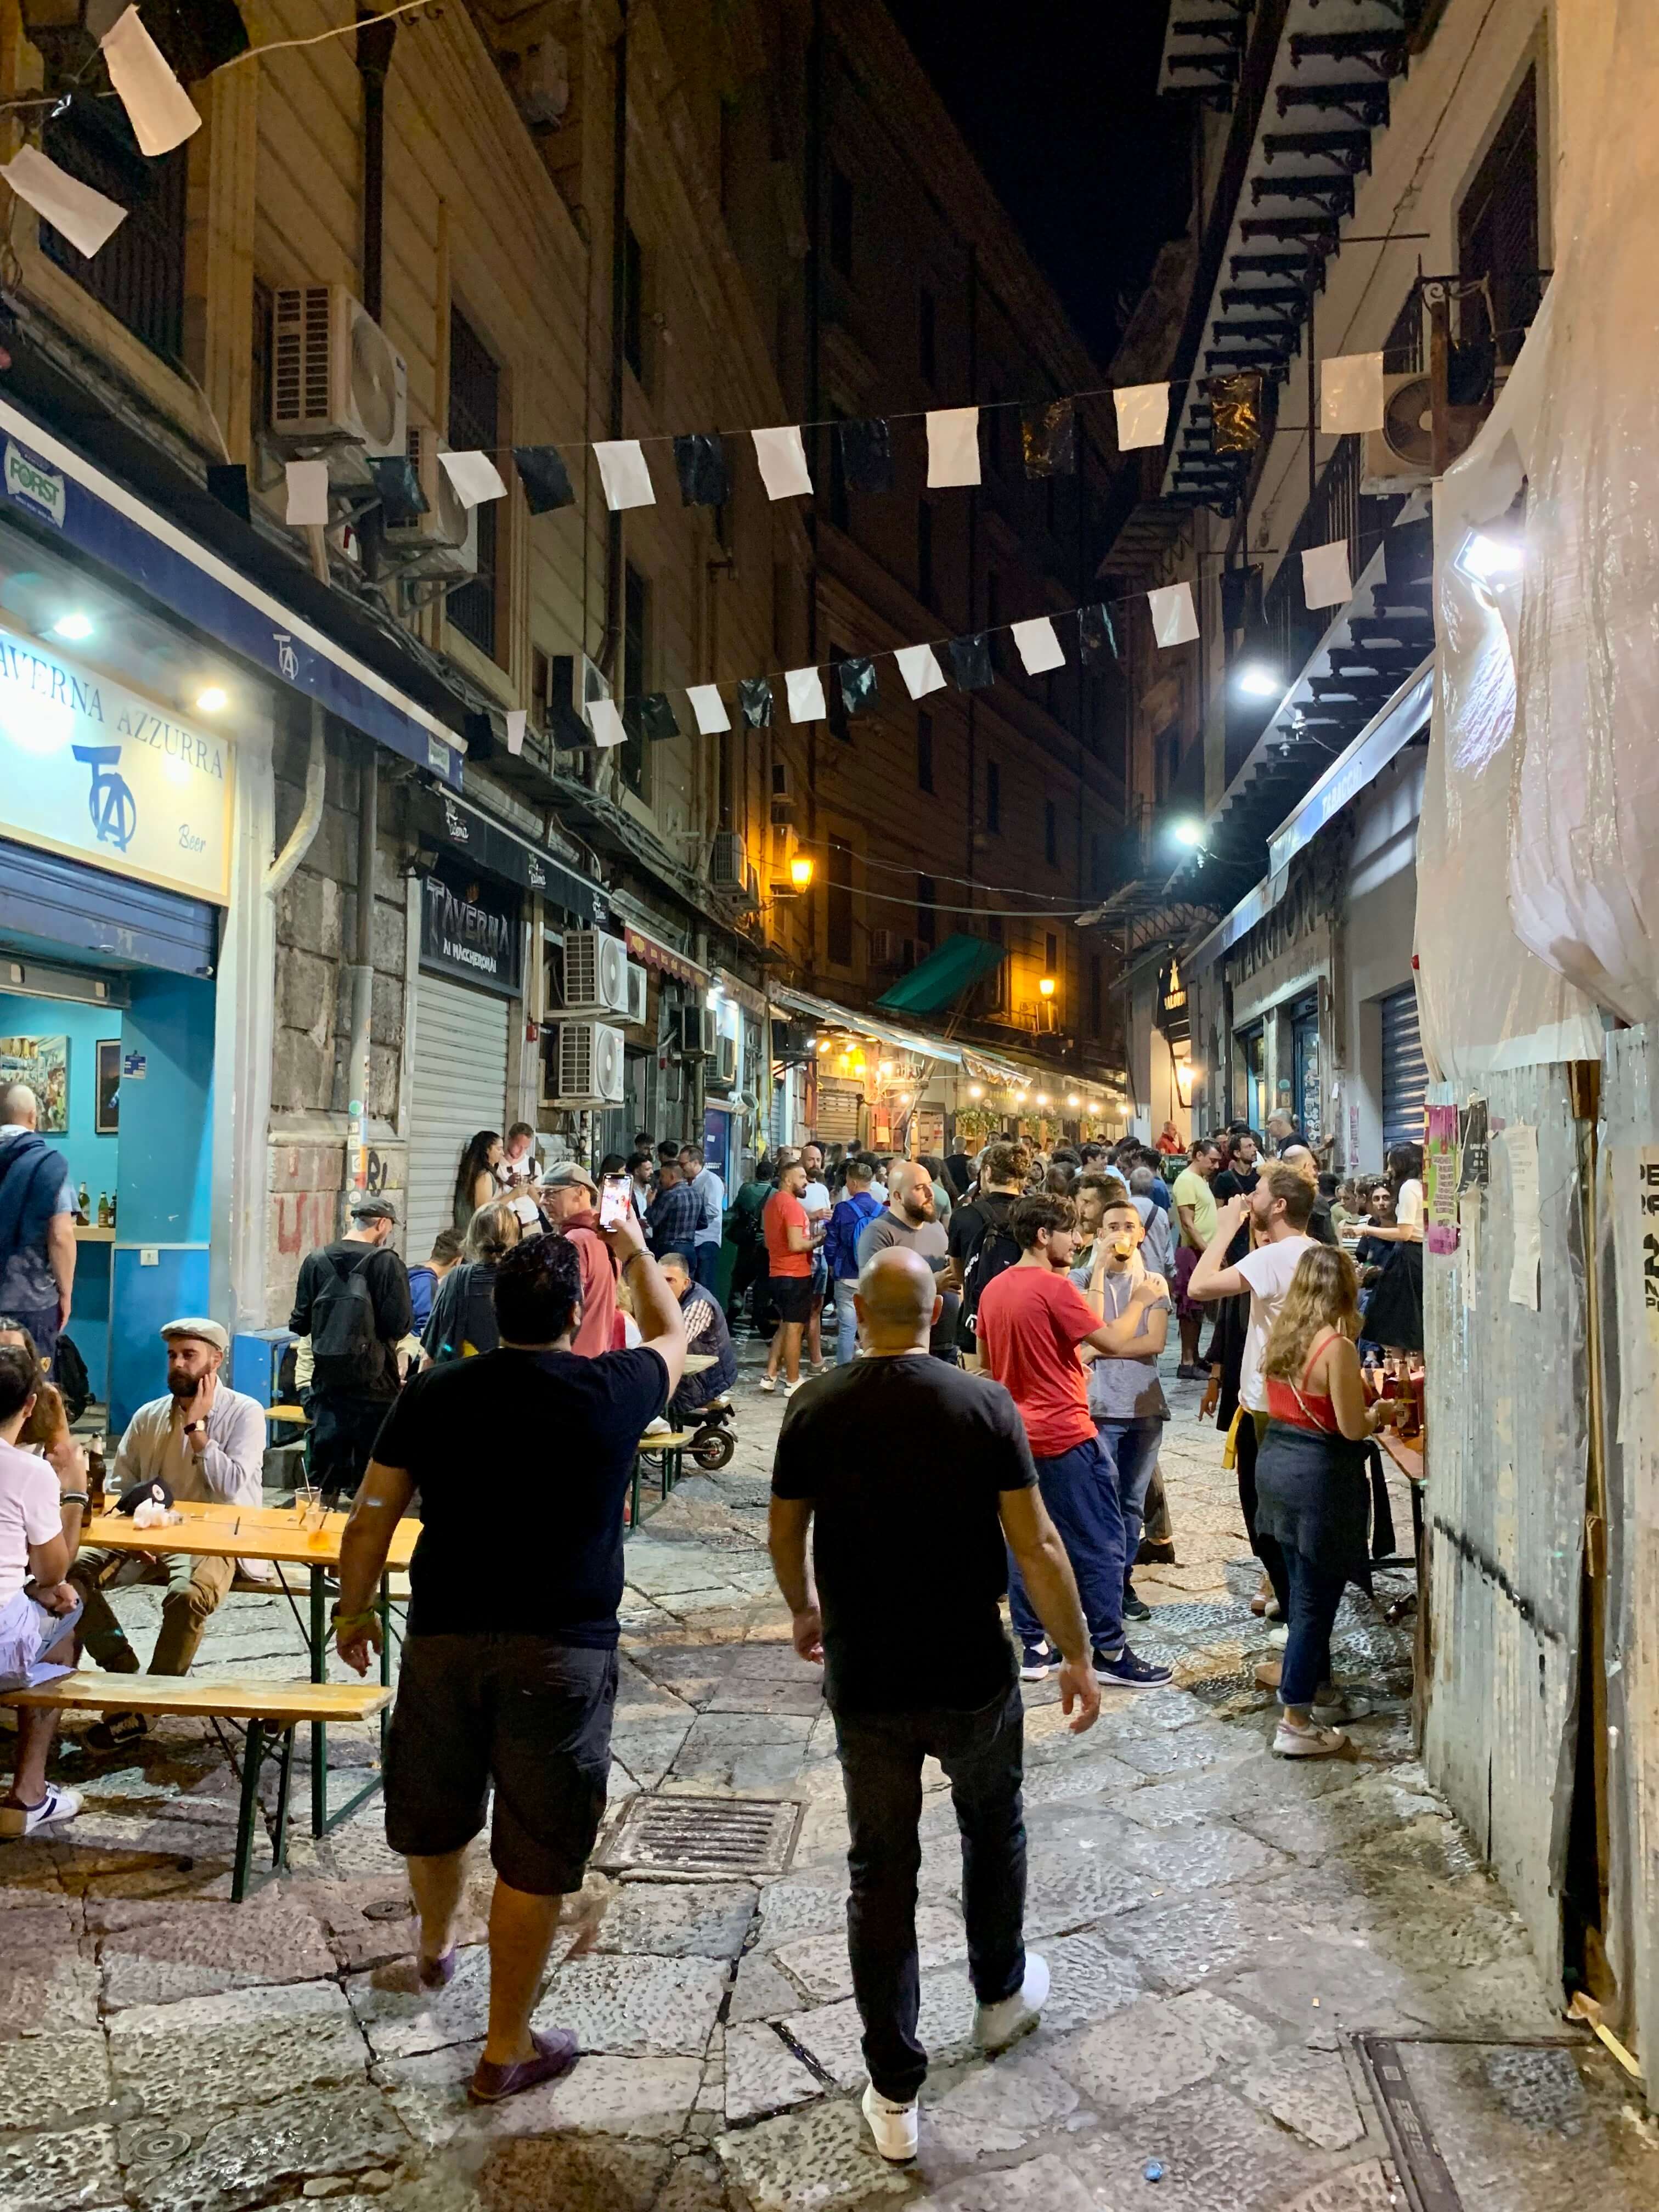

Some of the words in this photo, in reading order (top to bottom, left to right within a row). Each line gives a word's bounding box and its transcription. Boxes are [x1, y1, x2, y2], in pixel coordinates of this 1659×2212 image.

[10, 456, 60, 506] FORST
[116, 708, 223, 780] AZZURRA
[1322, 764, 1362, 820] TABACCHI
[178, 824, 207, 854] Beer
[427, 874, 510, 957] TAVERNA
